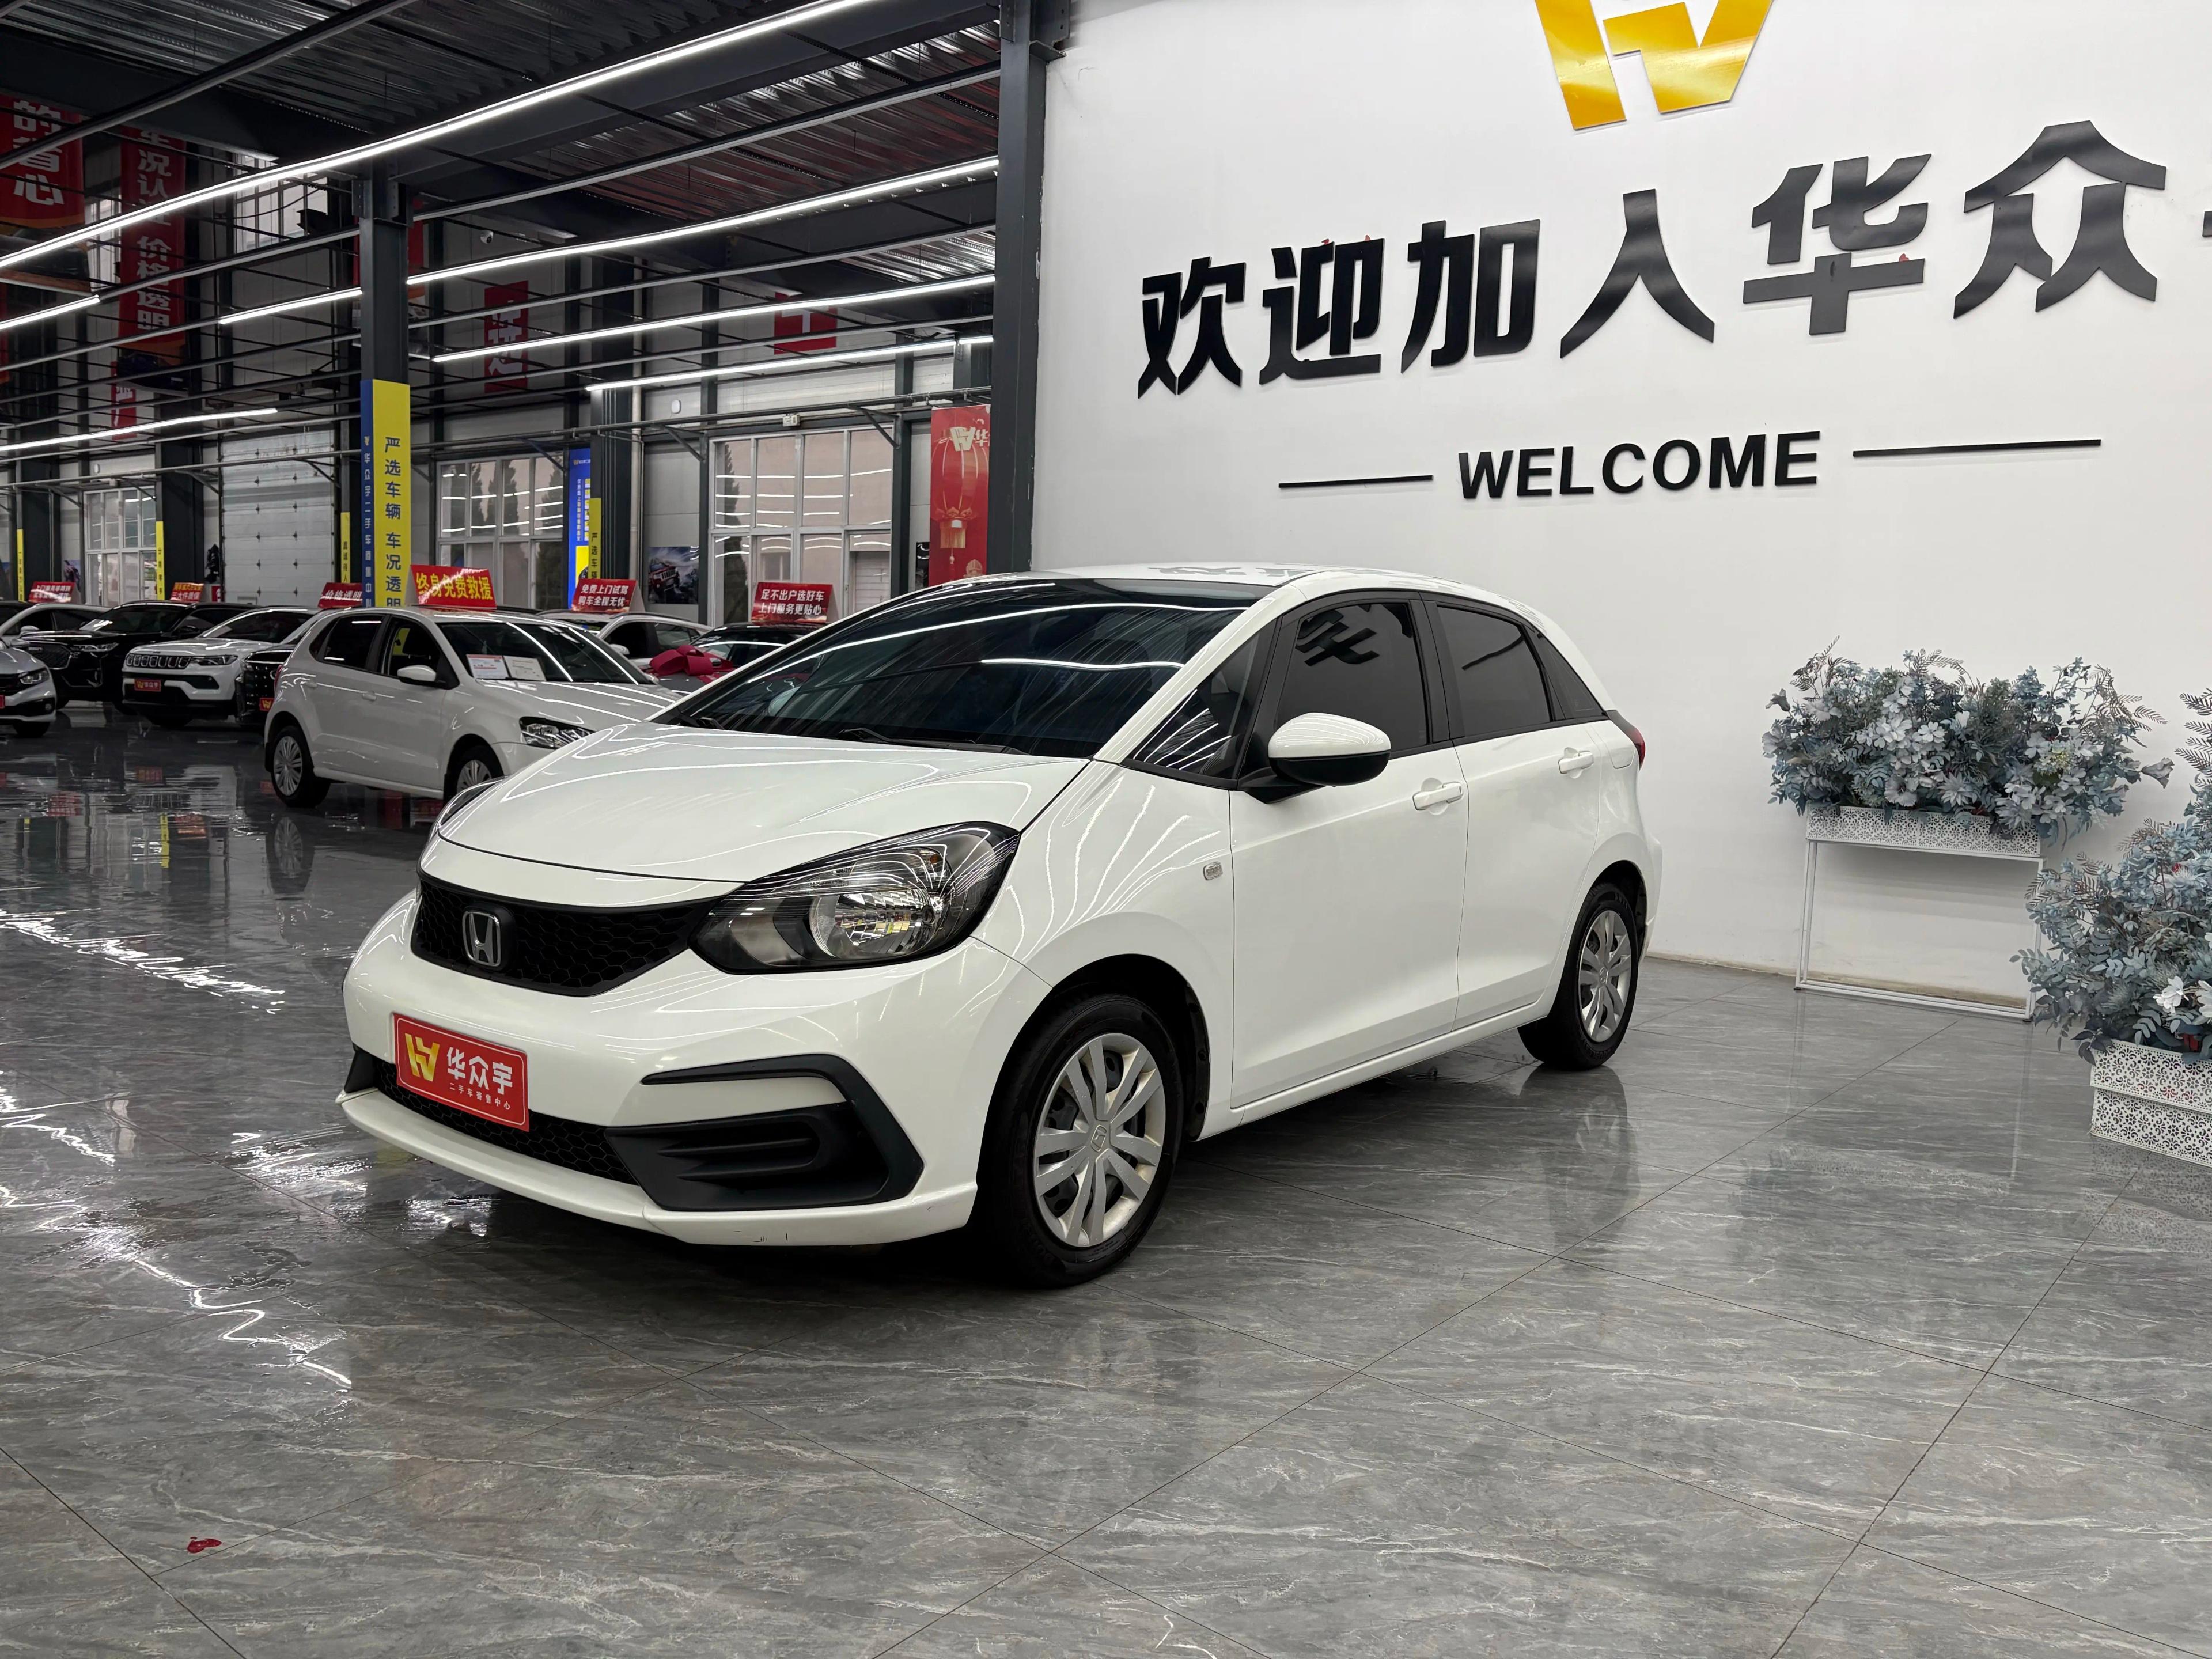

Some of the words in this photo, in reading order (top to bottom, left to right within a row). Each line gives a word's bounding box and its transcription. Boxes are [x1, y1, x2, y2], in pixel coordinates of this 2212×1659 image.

[1137, 120, 2212, 399] 欢迎加入华众
[975, 429, 990, 447] 华
[384, 437, 402, 520] 严选车辆
[1458, 431, 1820, 500] WELCOME
[416, 573, 493, 600] 终身免费救援
[581, 584, 629, 595] 免费上门试驾
[760, 589, 825, 602] 足不出户选好车
[578, 595, 626, 607] 购车全程无忧
[758, 602, 822, 616] 上门服务更贴心
[446, 1047, 513, 1095] 华众宇
[449, 1082, 511, 1111] 二手车寄售中心
